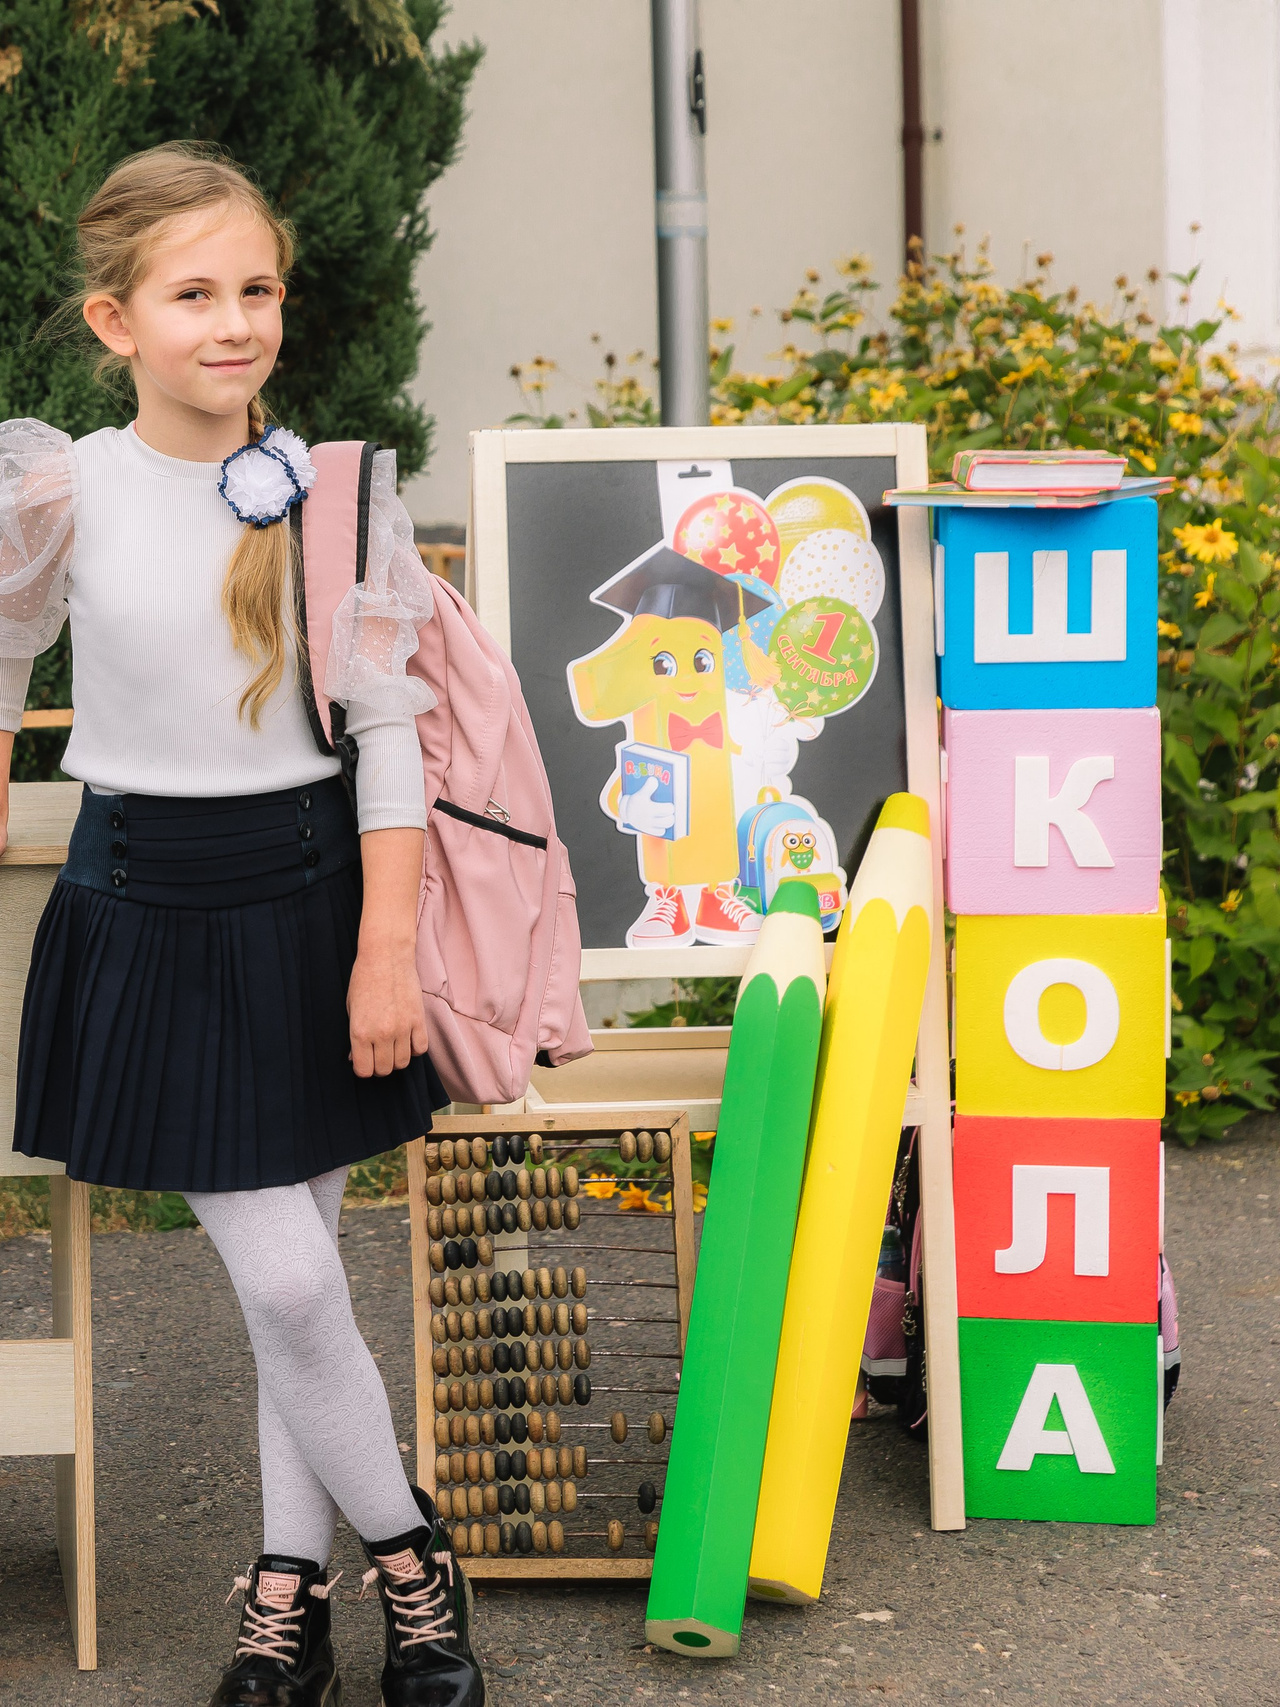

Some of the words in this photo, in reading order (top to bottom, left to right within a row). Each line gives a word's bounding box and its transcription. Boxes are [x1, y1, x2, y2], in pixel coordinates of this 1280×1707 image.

[777, 634, 858, 687] СЕНТЯБРЯ
[801, 612, 846, 665] 1
[625, 760, 670, 785] АЗБУКА
